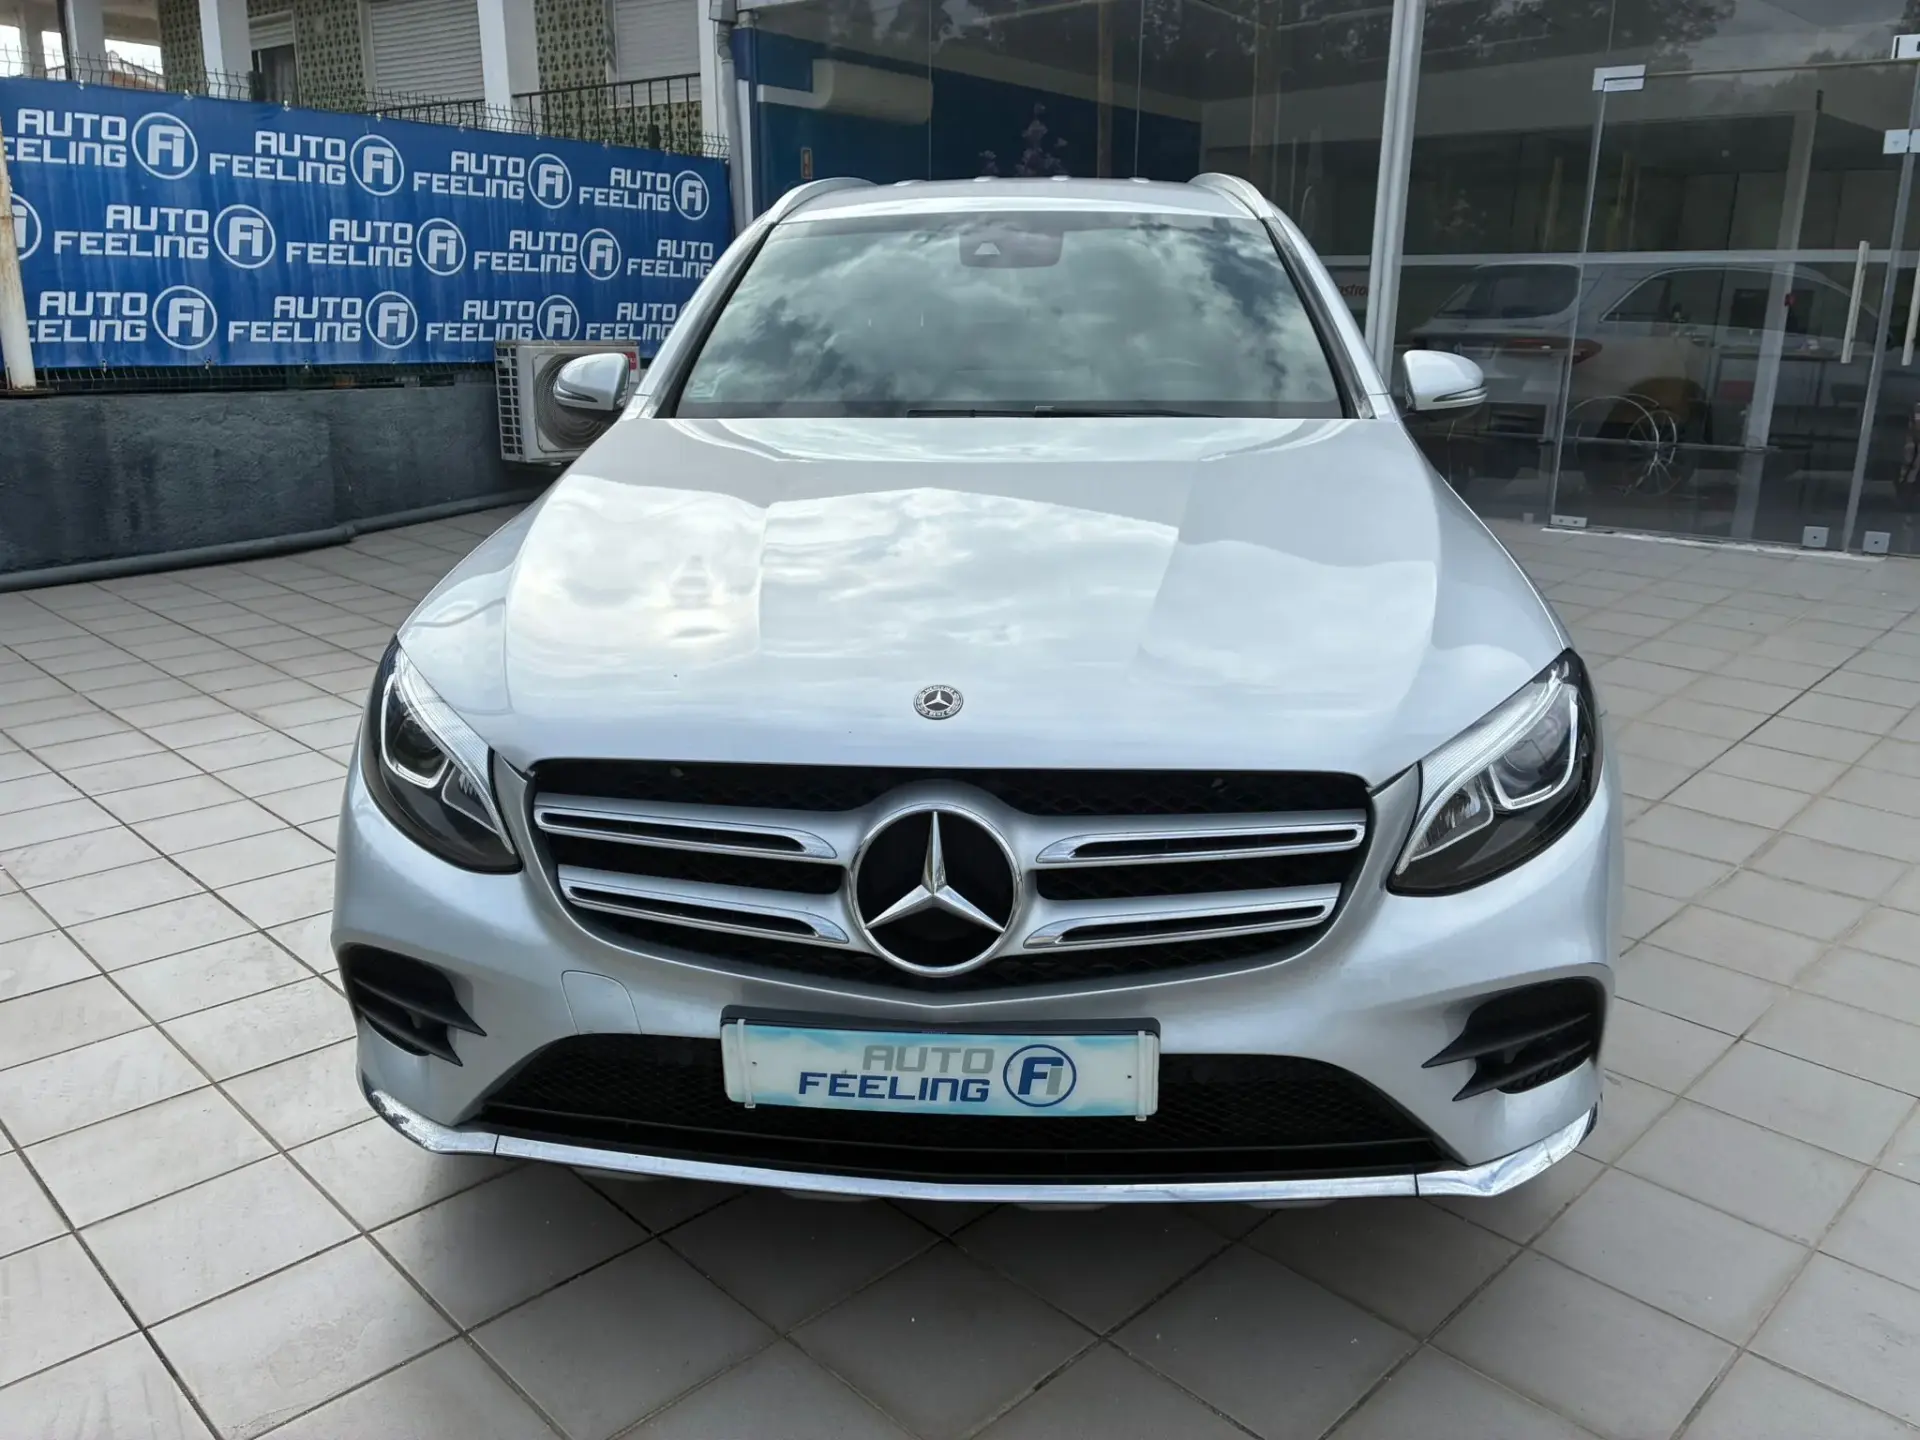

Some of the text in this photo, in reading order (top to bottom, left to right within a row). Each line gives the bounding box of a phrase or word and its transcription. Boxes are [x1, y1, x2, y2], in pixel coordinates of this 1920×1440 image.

[18, 108, 127, 141] AUTO
[3, 136, 127, 168] ELING
[255, 130, 346, 161] AUTO
[209, 152, 346, 185] FEELING
[450, 150, 525, 178] AUTO
[413, 171, 525, 200] FEELING
[610, 167, 671, 192] AUTO
[579, 186, 671, 212] FEELING
[106, 204, 209, 234] AUTO
[329, 218, 412, 244] AUTO
[54, 230, 209, 260] FEELING
[508, 229, 578, 253] AUTO
[657, 238, 713, 260] AUTO
[286, 241, 413, 268] FEELING
[473, 251, 577, 274] FEELING
[626, 258, 713, 279] FEELING
[39, 291, 148, 316] AUTO
[273, 296, 363, 319] AUTO
[462, 300, 535, 321] AUTO
[616, 302, 677, 322] AUTO
[27, 319, 147, 343] ELING
[227, 321, 362, 343] FEELING
[425, 322, 533, 342] FEELING
[862, 1044, 996, 1074] AUTO
[798, 1072, 991, 1102] FEELING
